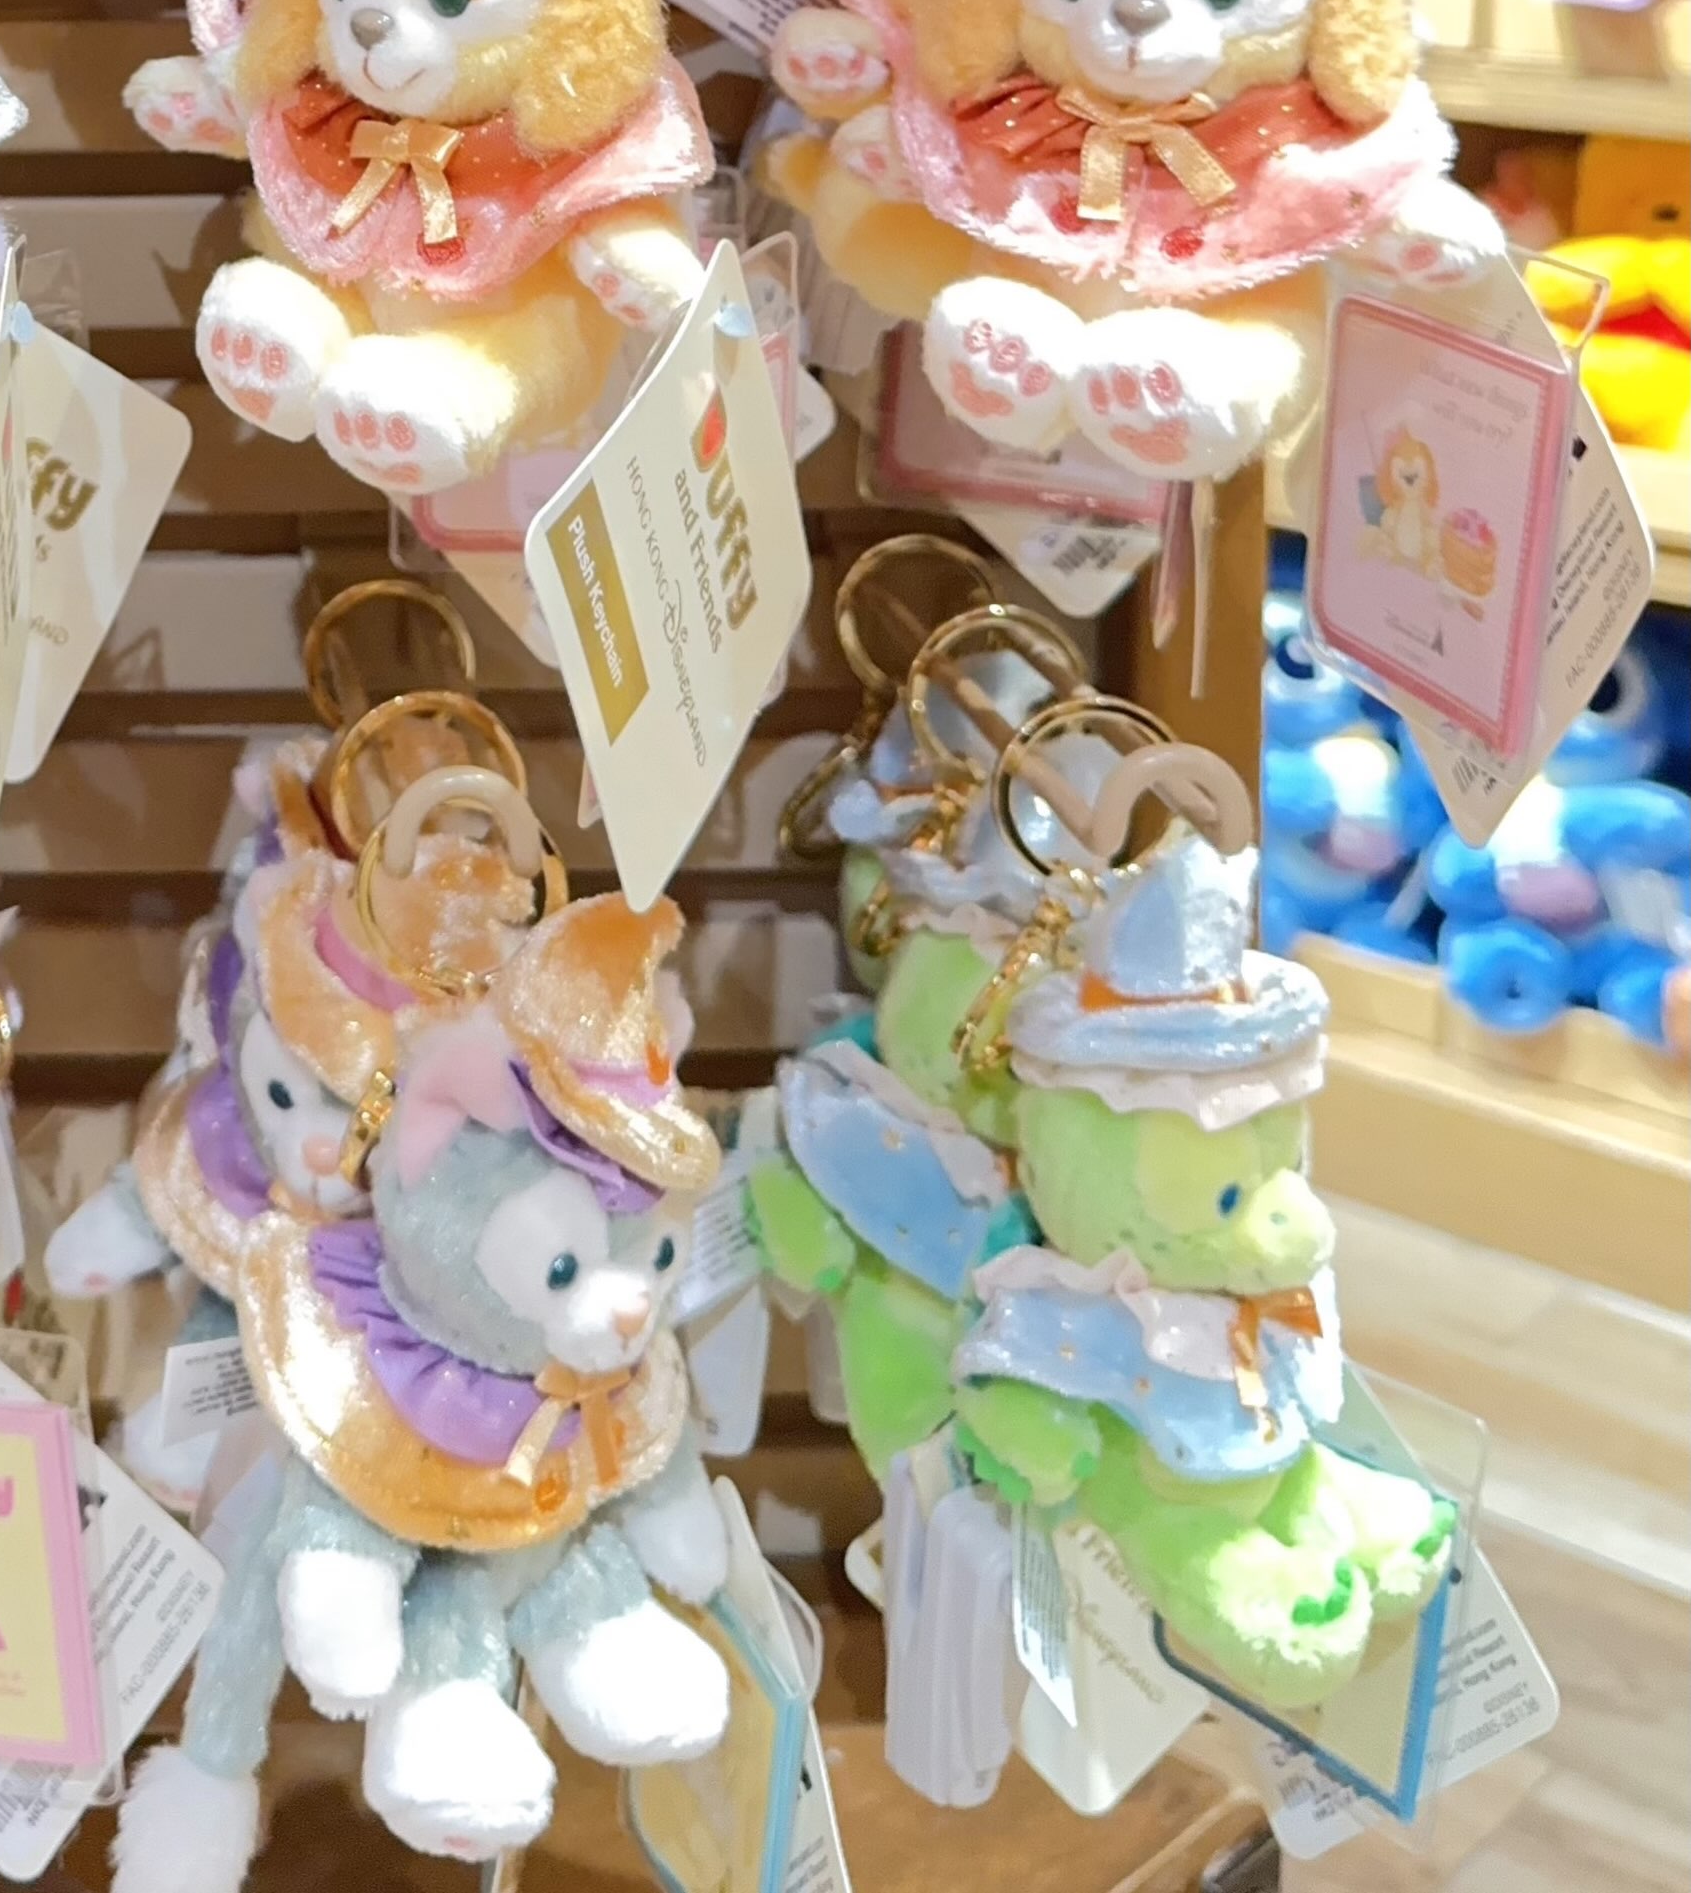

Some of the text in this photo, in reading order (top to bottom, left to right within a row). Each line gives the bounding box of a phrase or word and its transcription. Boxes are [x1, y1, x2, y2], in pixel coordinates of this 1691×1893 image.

[626, 455, 650, 530] HONG
[646, 533, 669, 602] KONG
[675, 469, 723, 654] and Friends
[690, 383, 758, 631] Duffy
[568, 514, 624, 687] Plush Keychain
